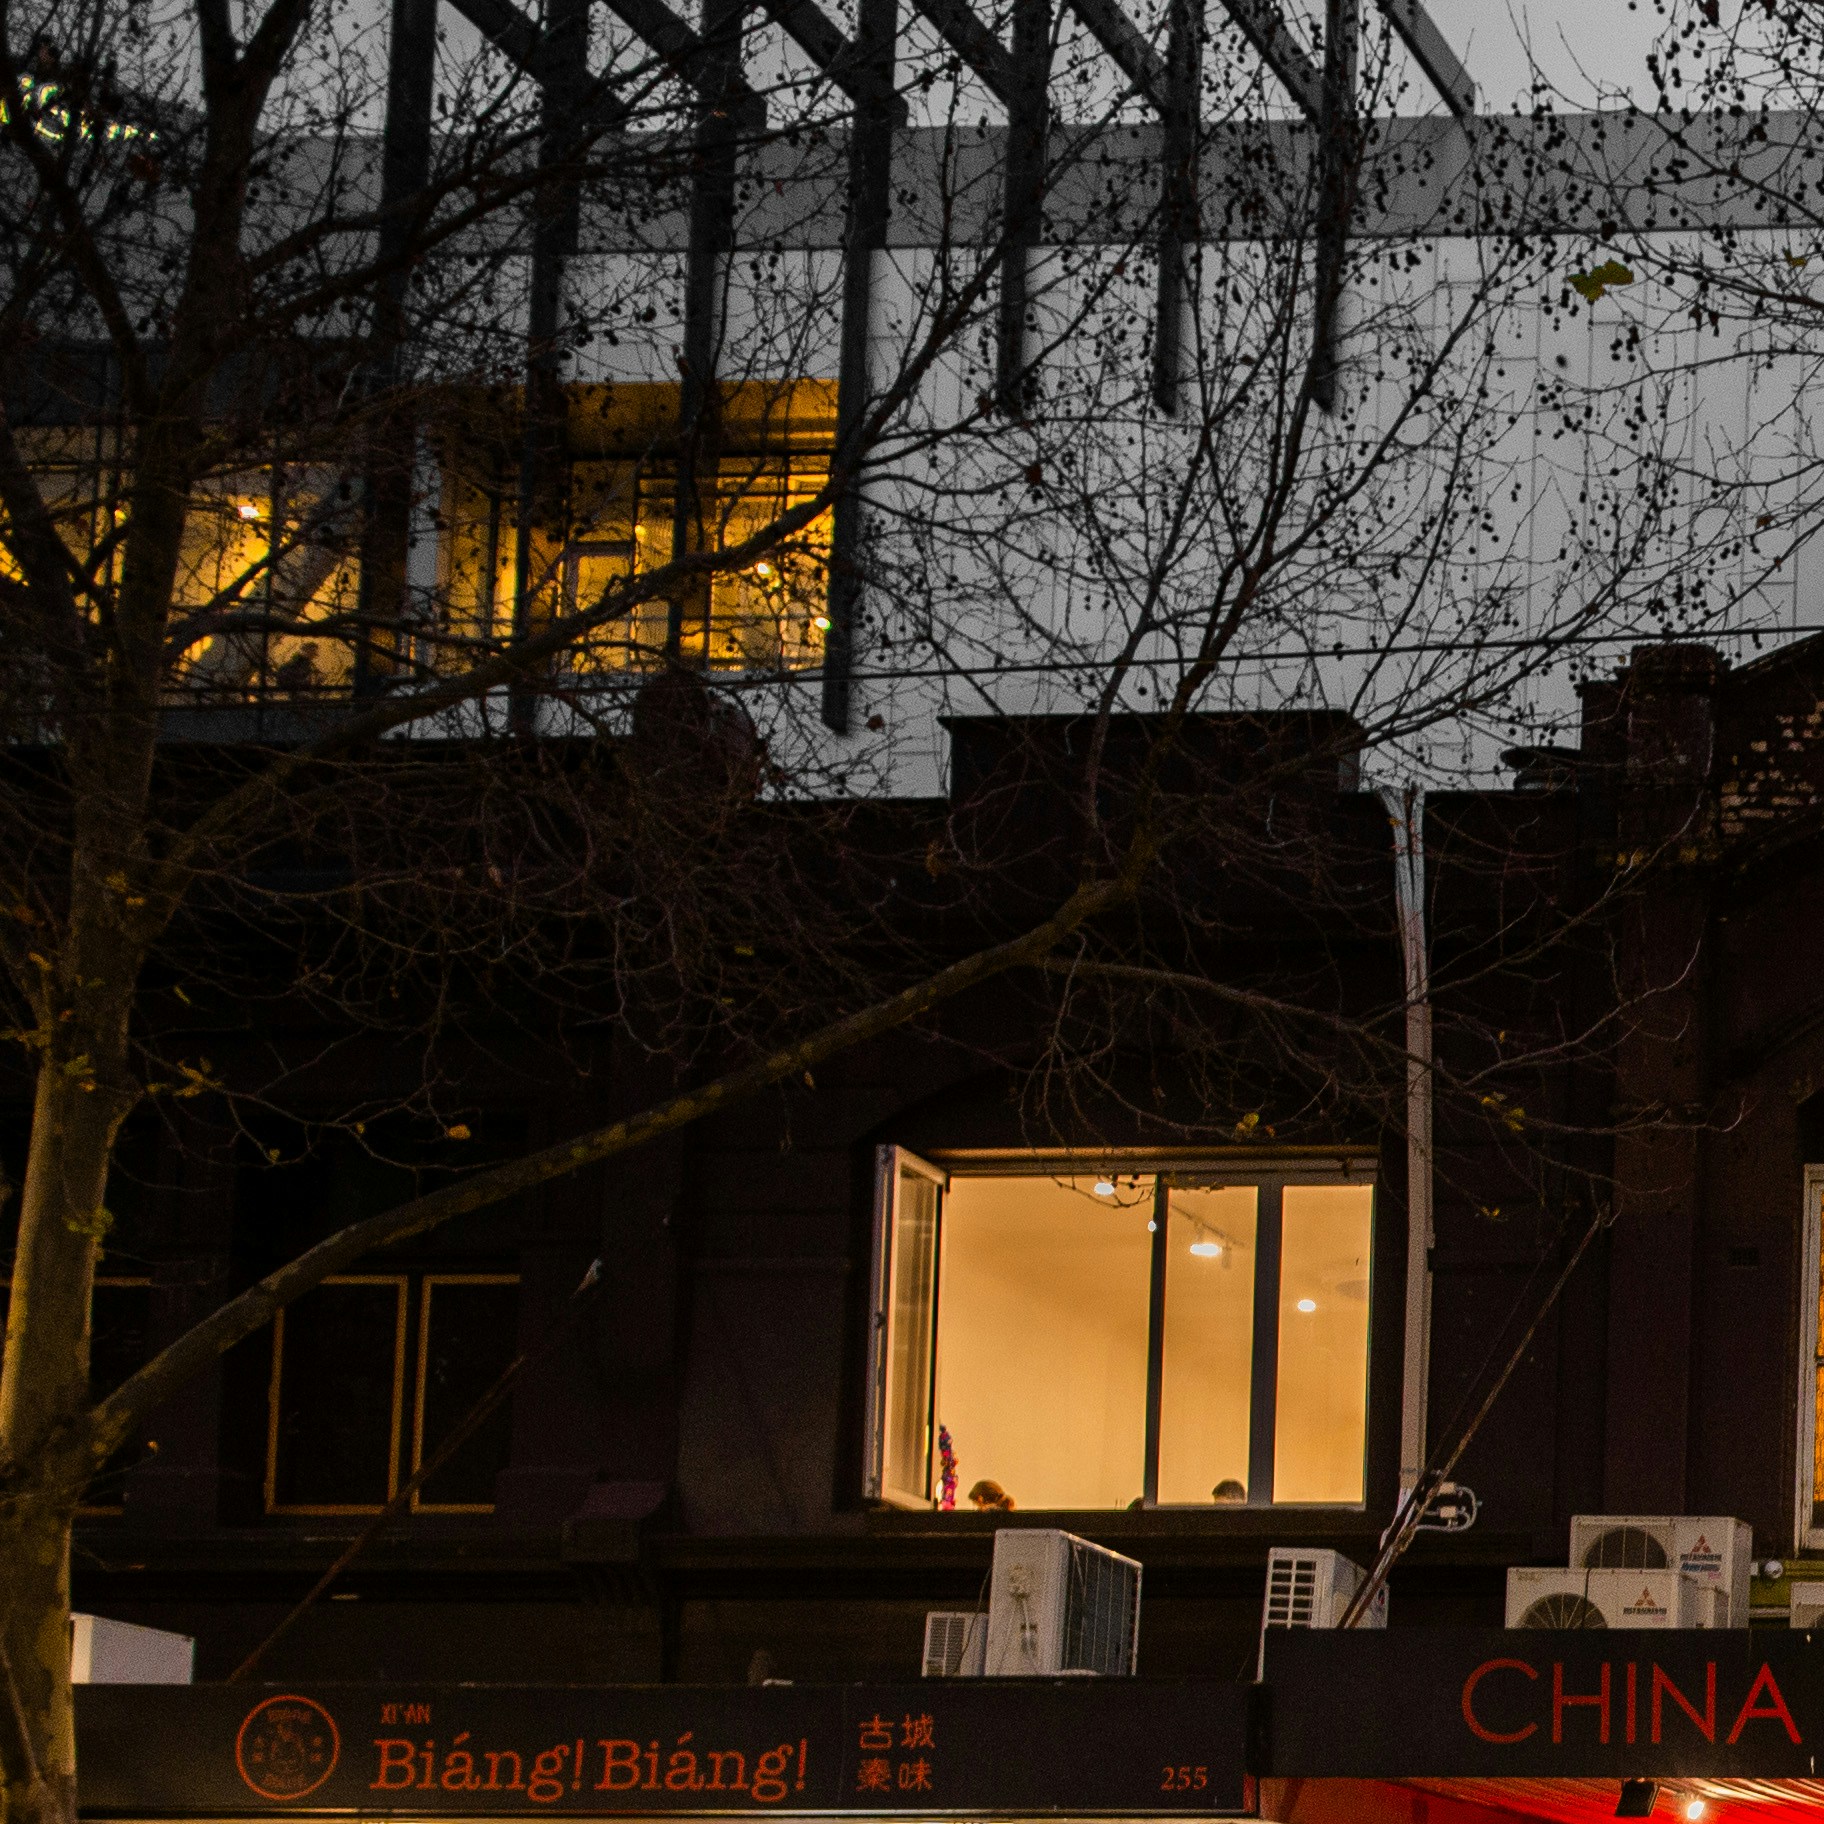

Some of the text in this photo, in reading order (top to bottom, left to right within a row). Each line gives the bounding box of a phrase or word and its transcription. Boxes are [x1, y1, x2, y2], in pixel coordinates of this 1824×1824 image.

[1462, 1658, 1802, 1744] CHINA
[858, 1713, 935, 1751] 古城
[370, 1731, 808, 1802] Biáng! Biáng!
[1161, 1767, 1208, 1791] 255
